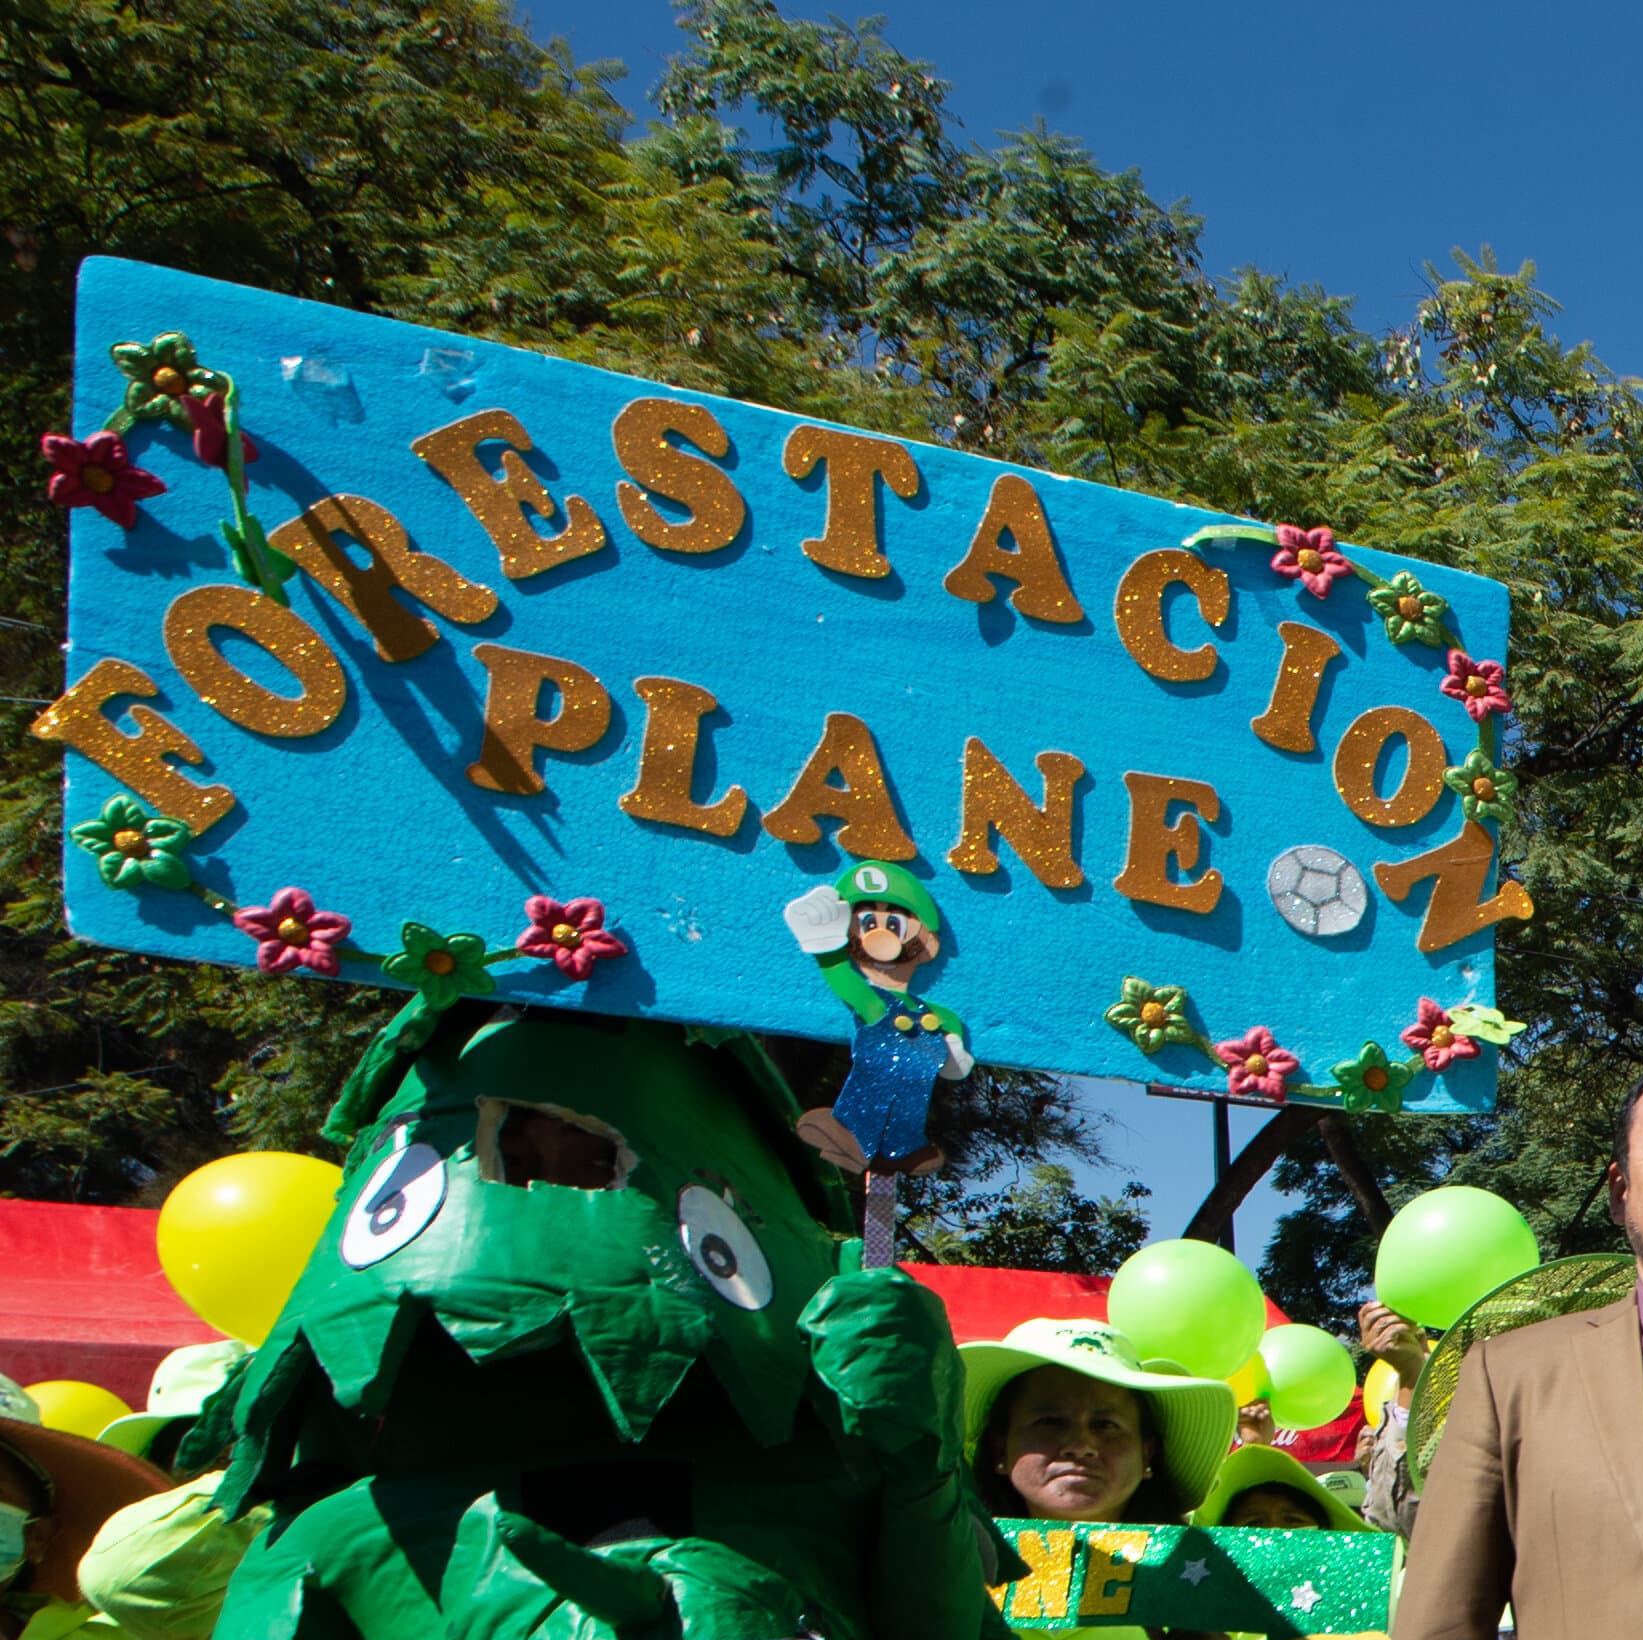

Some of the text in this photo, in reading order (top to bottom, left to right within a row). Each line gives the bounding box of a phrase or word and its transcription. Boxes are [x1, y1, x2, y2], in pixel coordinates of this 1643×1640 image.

[31, 397, 1533, 953] FORESTACION
[465, 643, 1223, 915] PLANE
[984, 1529, 1150, 1618] NE
